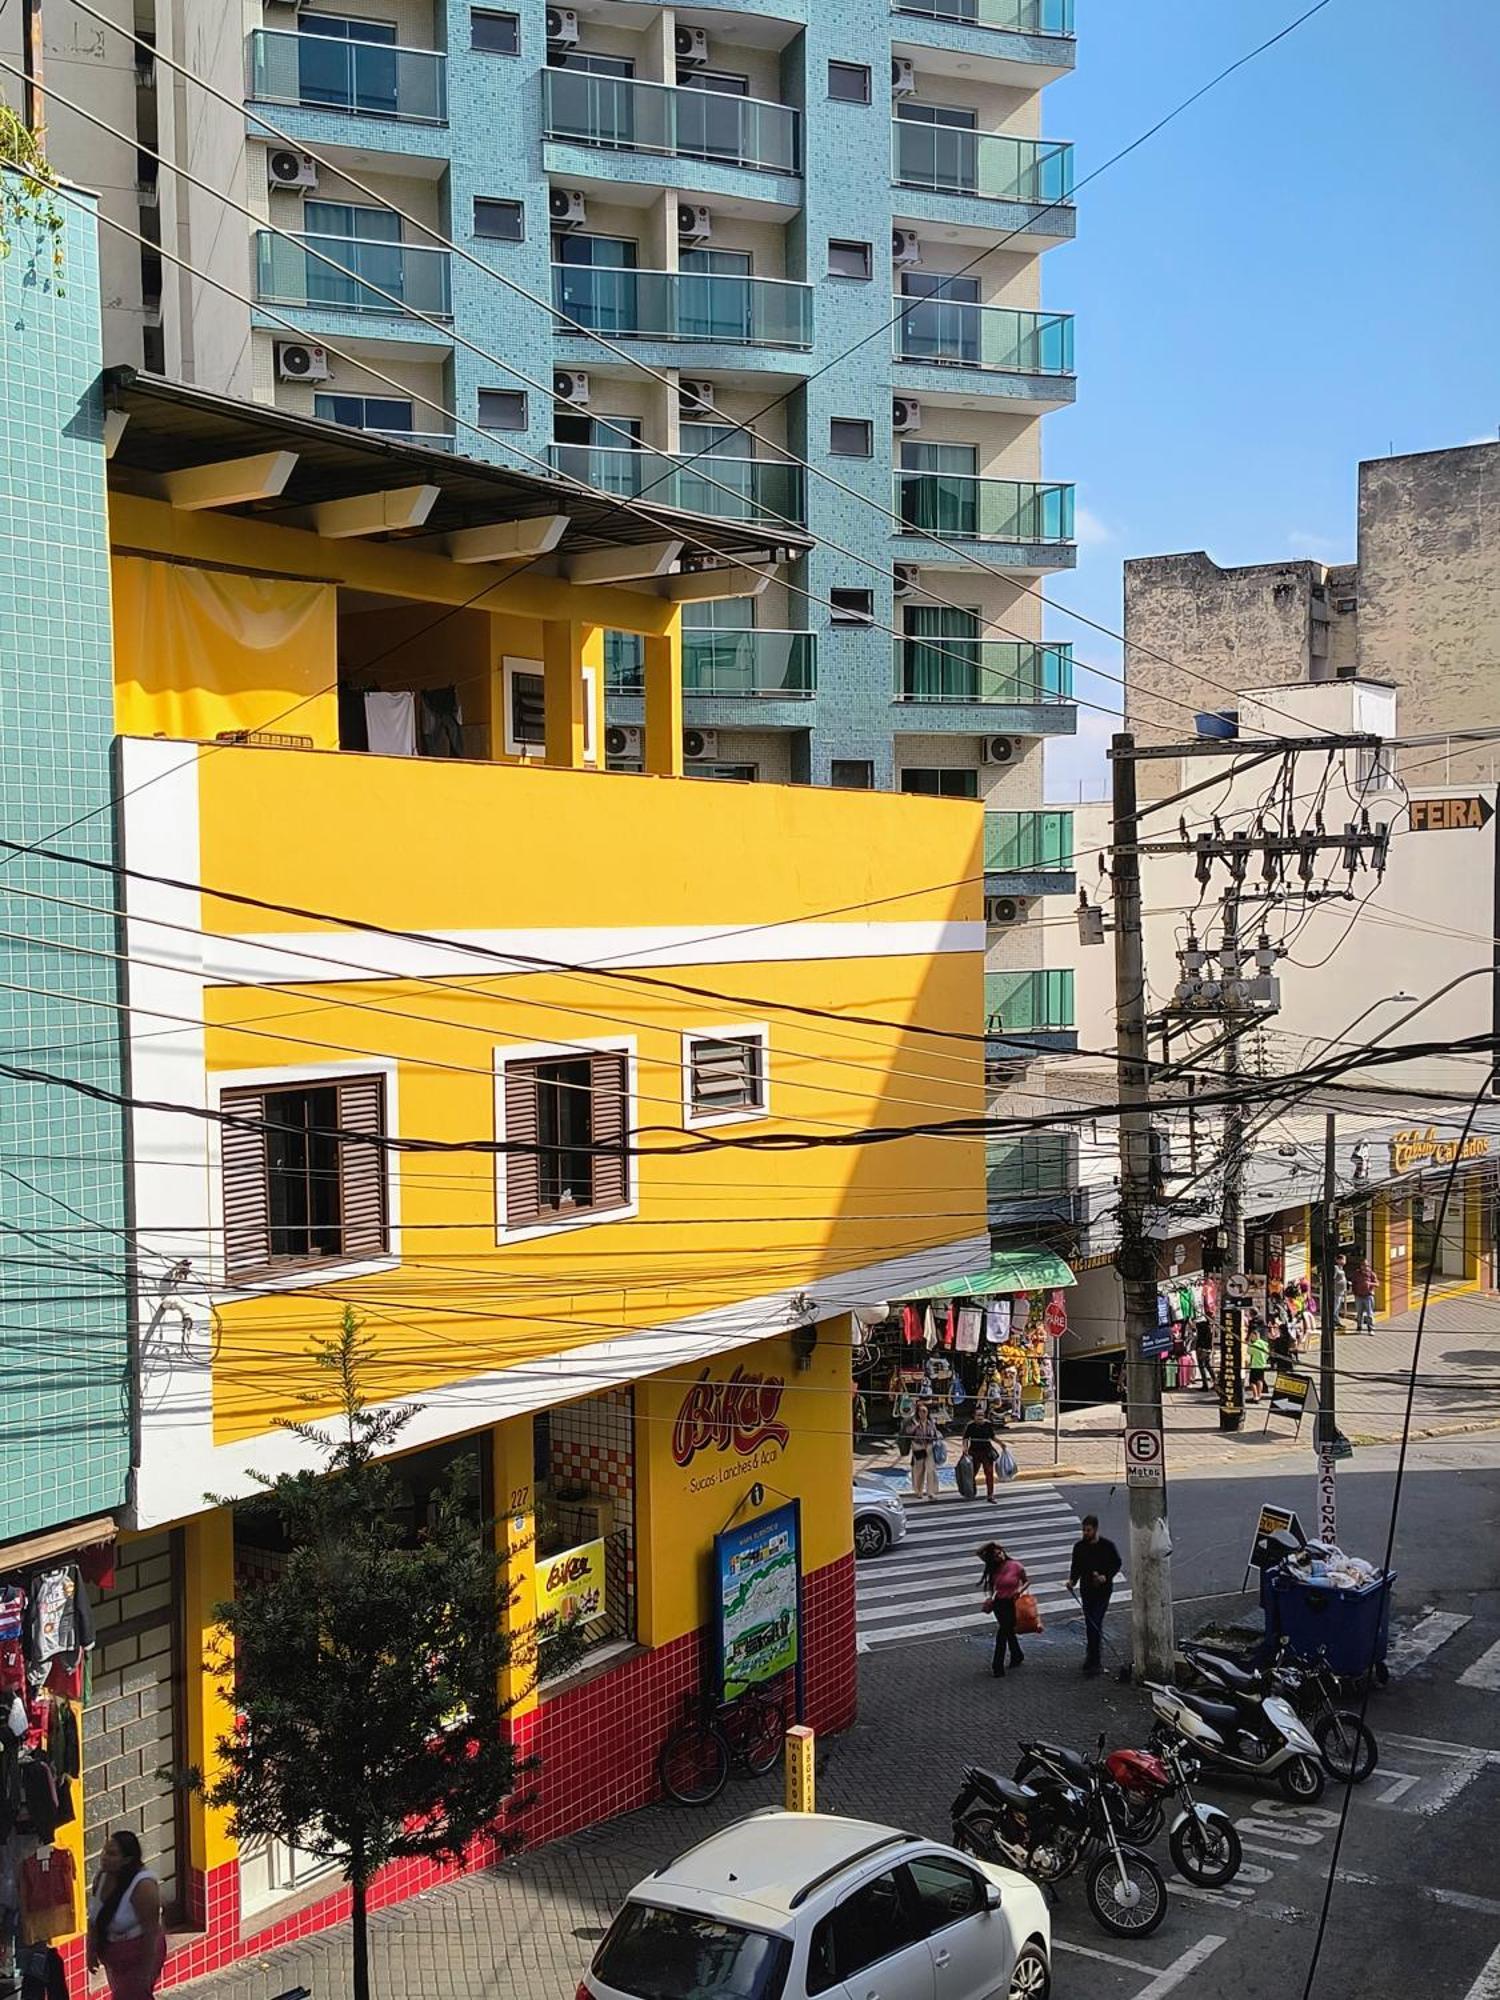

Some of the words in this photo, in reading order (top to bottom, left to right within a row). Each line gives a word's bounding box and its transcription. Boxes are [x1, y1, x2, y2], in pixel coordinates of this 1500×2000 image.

[1411, 800, 1483, 829] FEIRA
[1436, 1137, 1489, 1163] Calados
[1137, 1436, 1150, 1455] E
[719, 1460, 752, 1483] Lanches
[511, 1486, 529, 1508] 227
